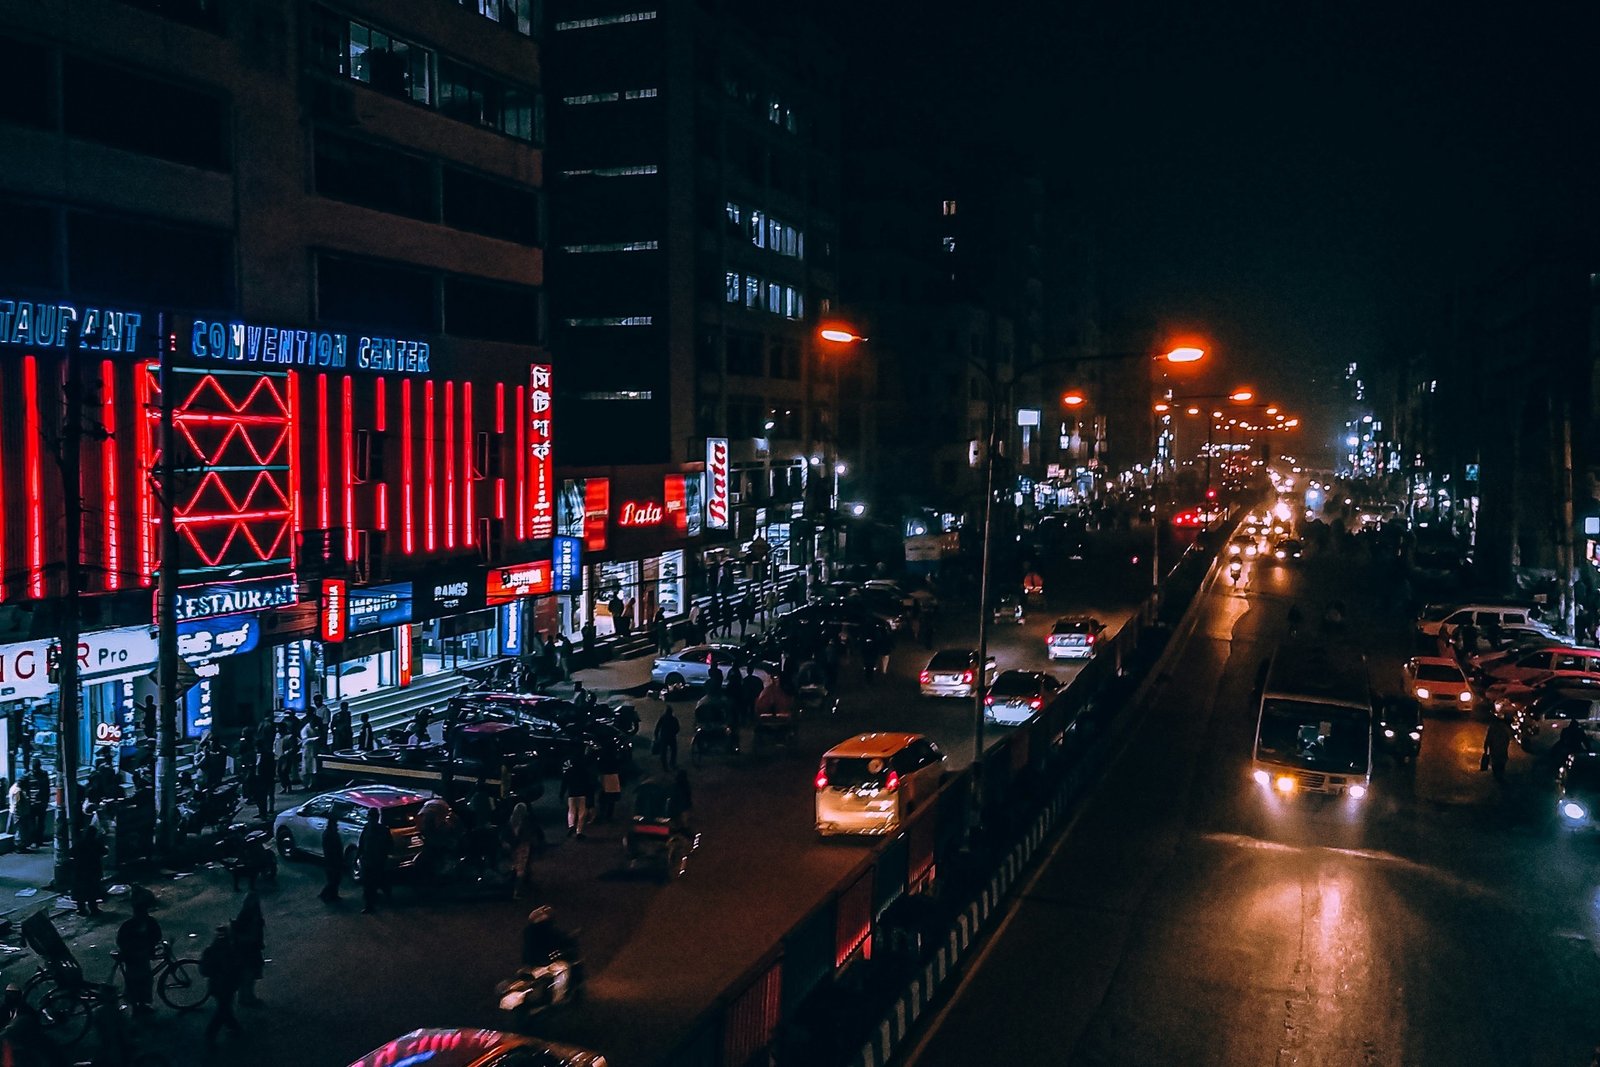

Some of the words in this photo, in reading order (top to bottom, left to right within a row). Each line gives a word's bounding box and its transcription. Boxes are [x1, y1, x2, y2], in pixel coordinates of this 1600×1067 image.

[192, 320, 348, 368] CONVENTION
[358, 336, 430, 373] CENTER
[709, 442, 726, 525] Bata
[620, 502, 662, 525] Bata
[562, 541, 572, 591] SAMSUNG
[434, 582, 469, 597] RANGS
[98, 648, 128, 666] Pro
[96, 722, 122, 740] 0%
